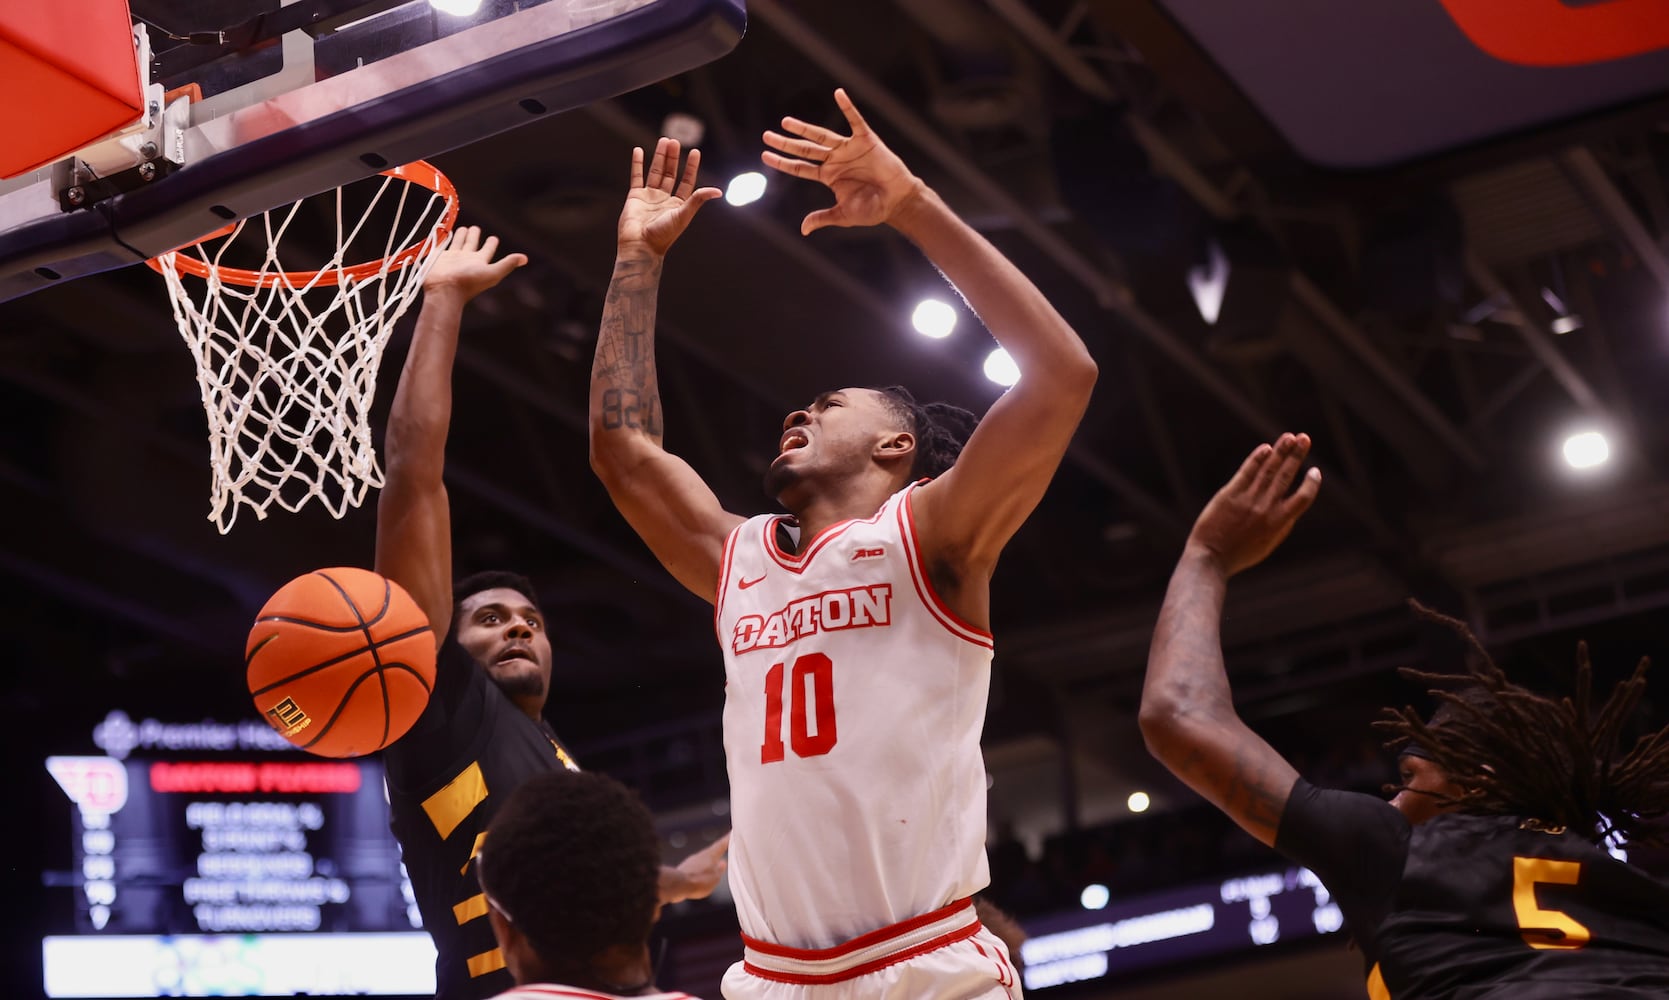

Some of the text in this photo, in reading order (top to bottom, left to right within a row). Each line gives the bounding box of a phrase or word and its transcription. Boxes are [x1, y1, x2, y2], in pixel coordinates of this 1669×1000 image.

[732, 583, 892, 656] DAYTON
[761, 652, 838, 765] 10
[1512, 856, 1590, 950] 5
